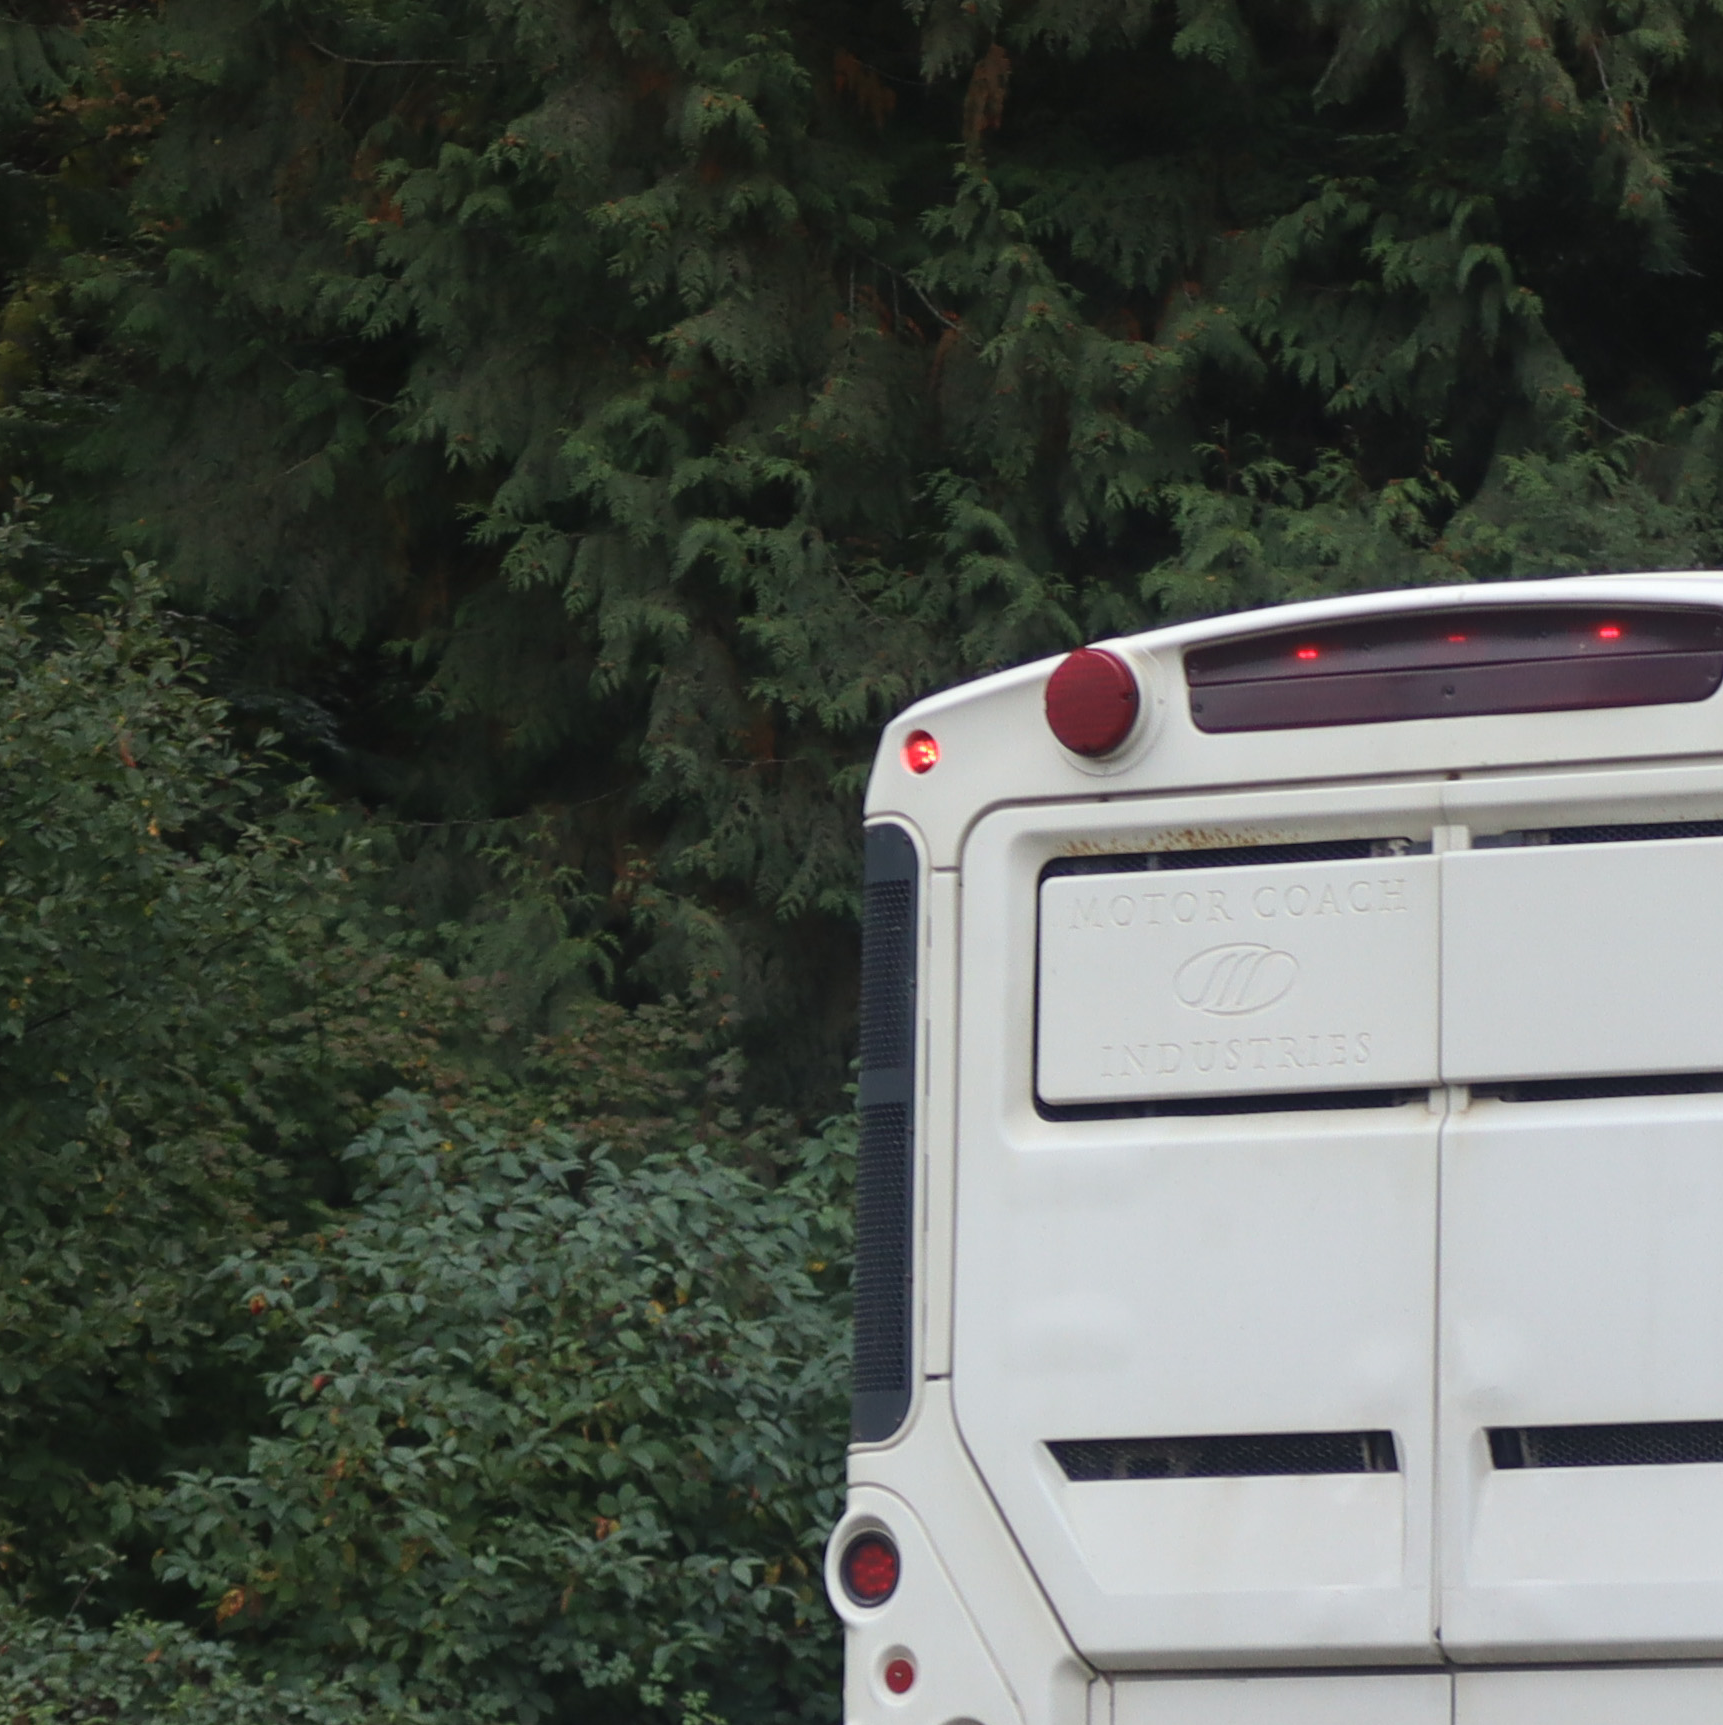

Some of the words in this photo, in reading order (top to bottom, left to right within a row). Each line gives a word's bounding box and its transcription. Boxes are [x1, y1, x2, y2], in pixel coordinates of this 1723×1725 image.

[1069, 889, 1233, 929] MOTOR
[1251, 879, 1409, 918] COACH
[1100, 1031, 1371, 1078] INDUSTRIES
